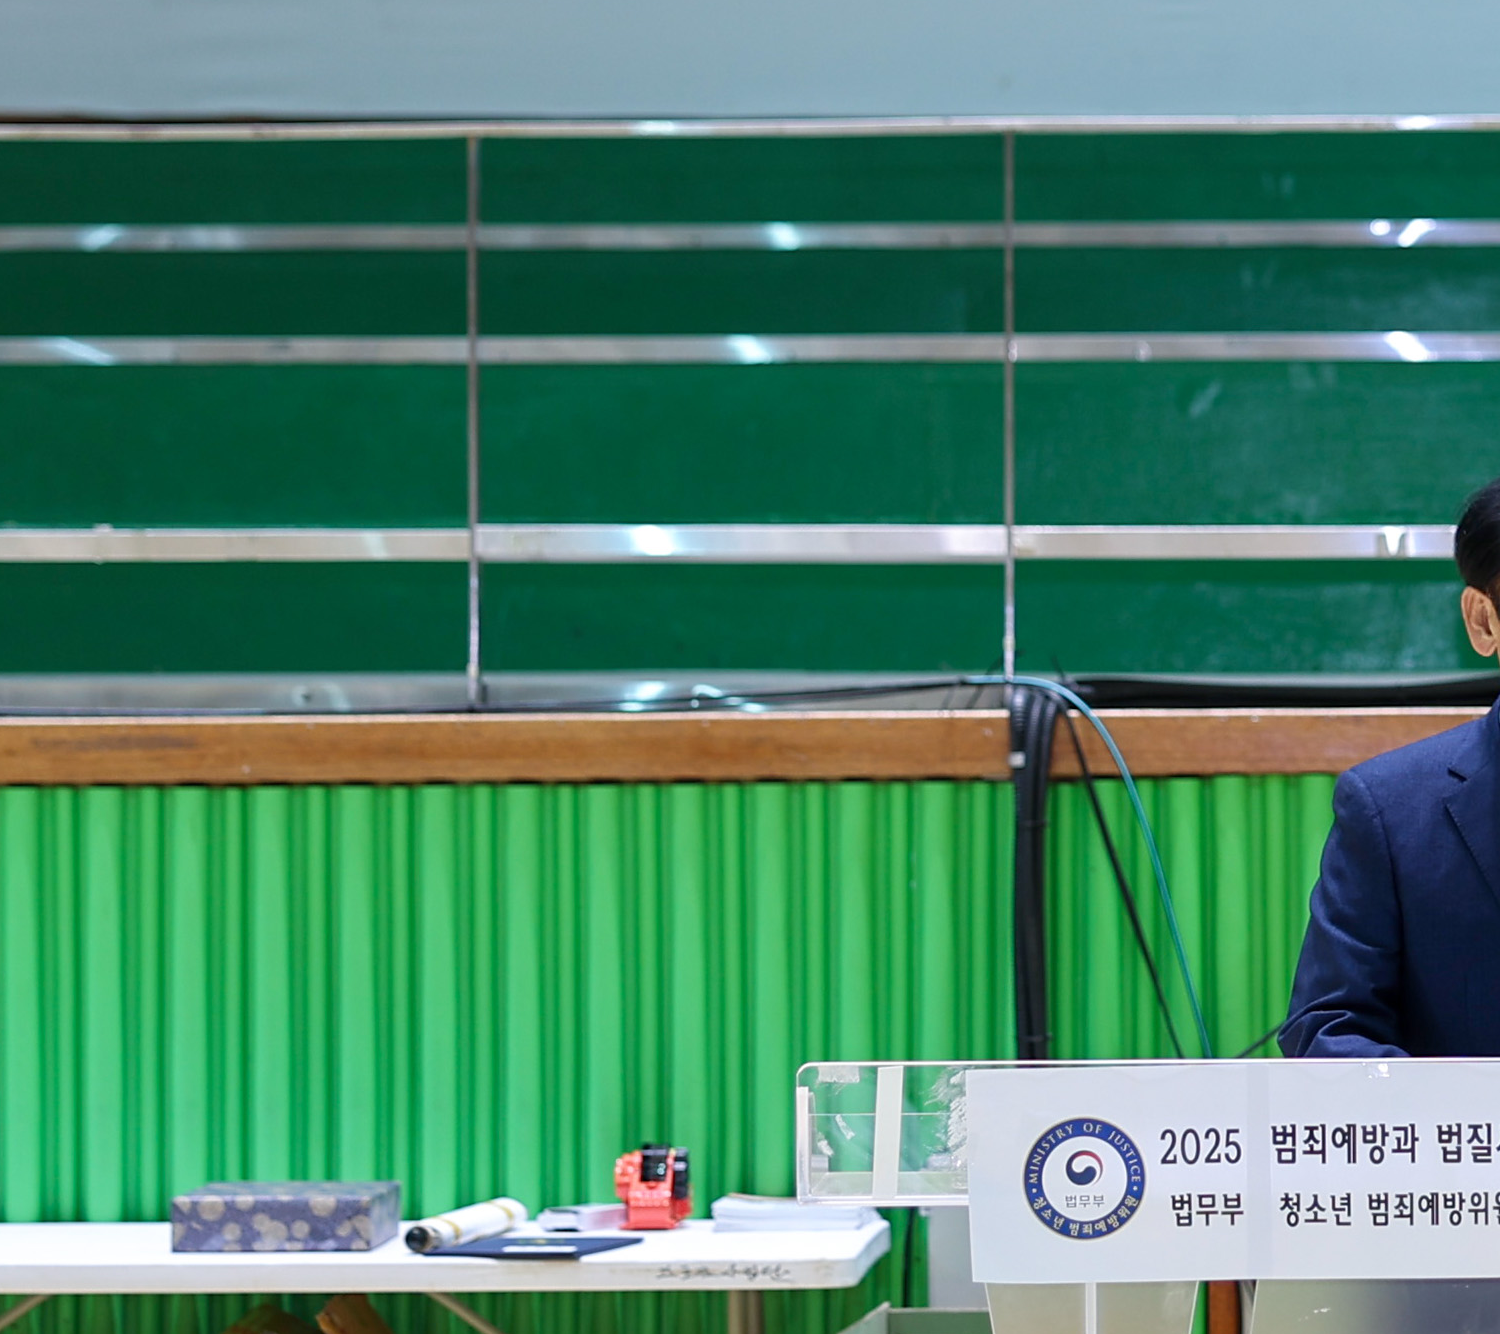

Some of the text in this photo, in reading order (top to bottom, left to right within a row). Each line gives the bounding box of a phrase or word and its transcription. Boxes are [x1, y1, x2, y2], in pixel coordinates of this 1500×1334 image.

[1028, 1122, 1142, 1185] MINISTRY OF JUSTICE
[1159, 1127, 1243, 1166] 2025
[1270, 1122, 1420, 1165] 범죄예방과
[1032, 1194, 1140, 1237] 청소년 범죄예방위원
[1065, 1194, 1106, 1208] 법무부
[1170, 1192, 1245, 1228] 법무부
[1278, 1191, 1354, 1228] 청소년
